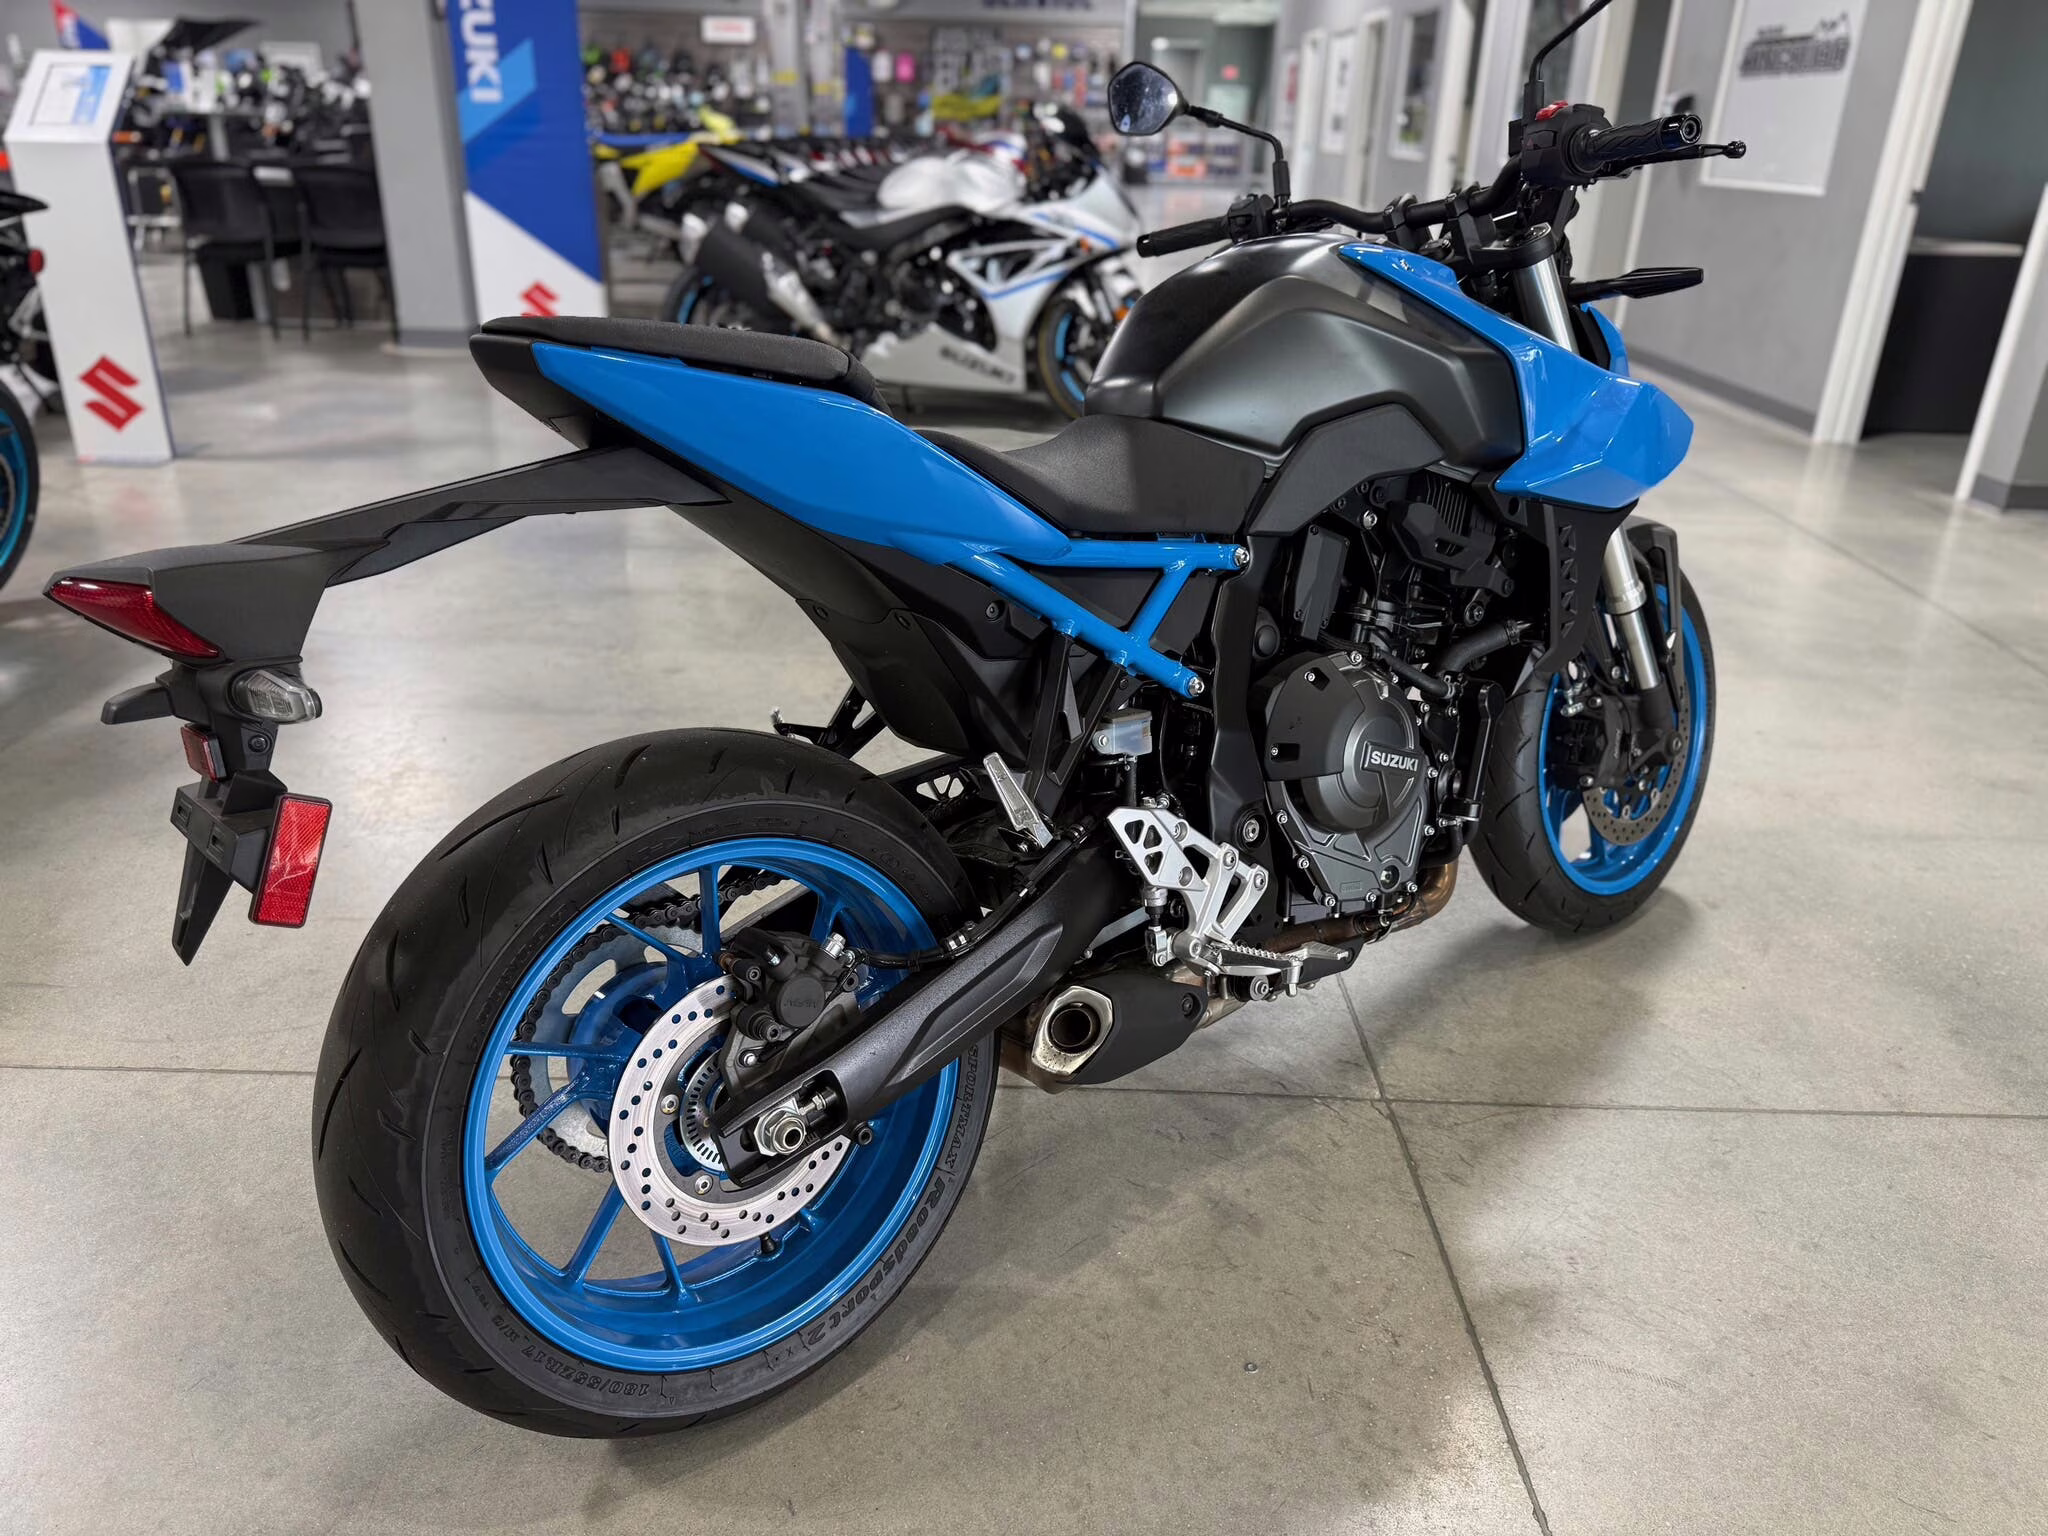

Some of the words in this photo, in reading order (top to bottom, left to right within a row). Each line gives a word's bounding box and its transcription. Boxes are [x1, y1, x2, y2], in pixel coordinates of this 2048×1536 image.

[1370, 750, 1419, 772] SUZUKI
[944, 1045, 980, 1169] SPORTMAX
[830, 1178, 947, 1331] Roadsport
[808, 1327, 826, 1346] 2
[522, 1346, 649, 1396] 180/55ZR17
